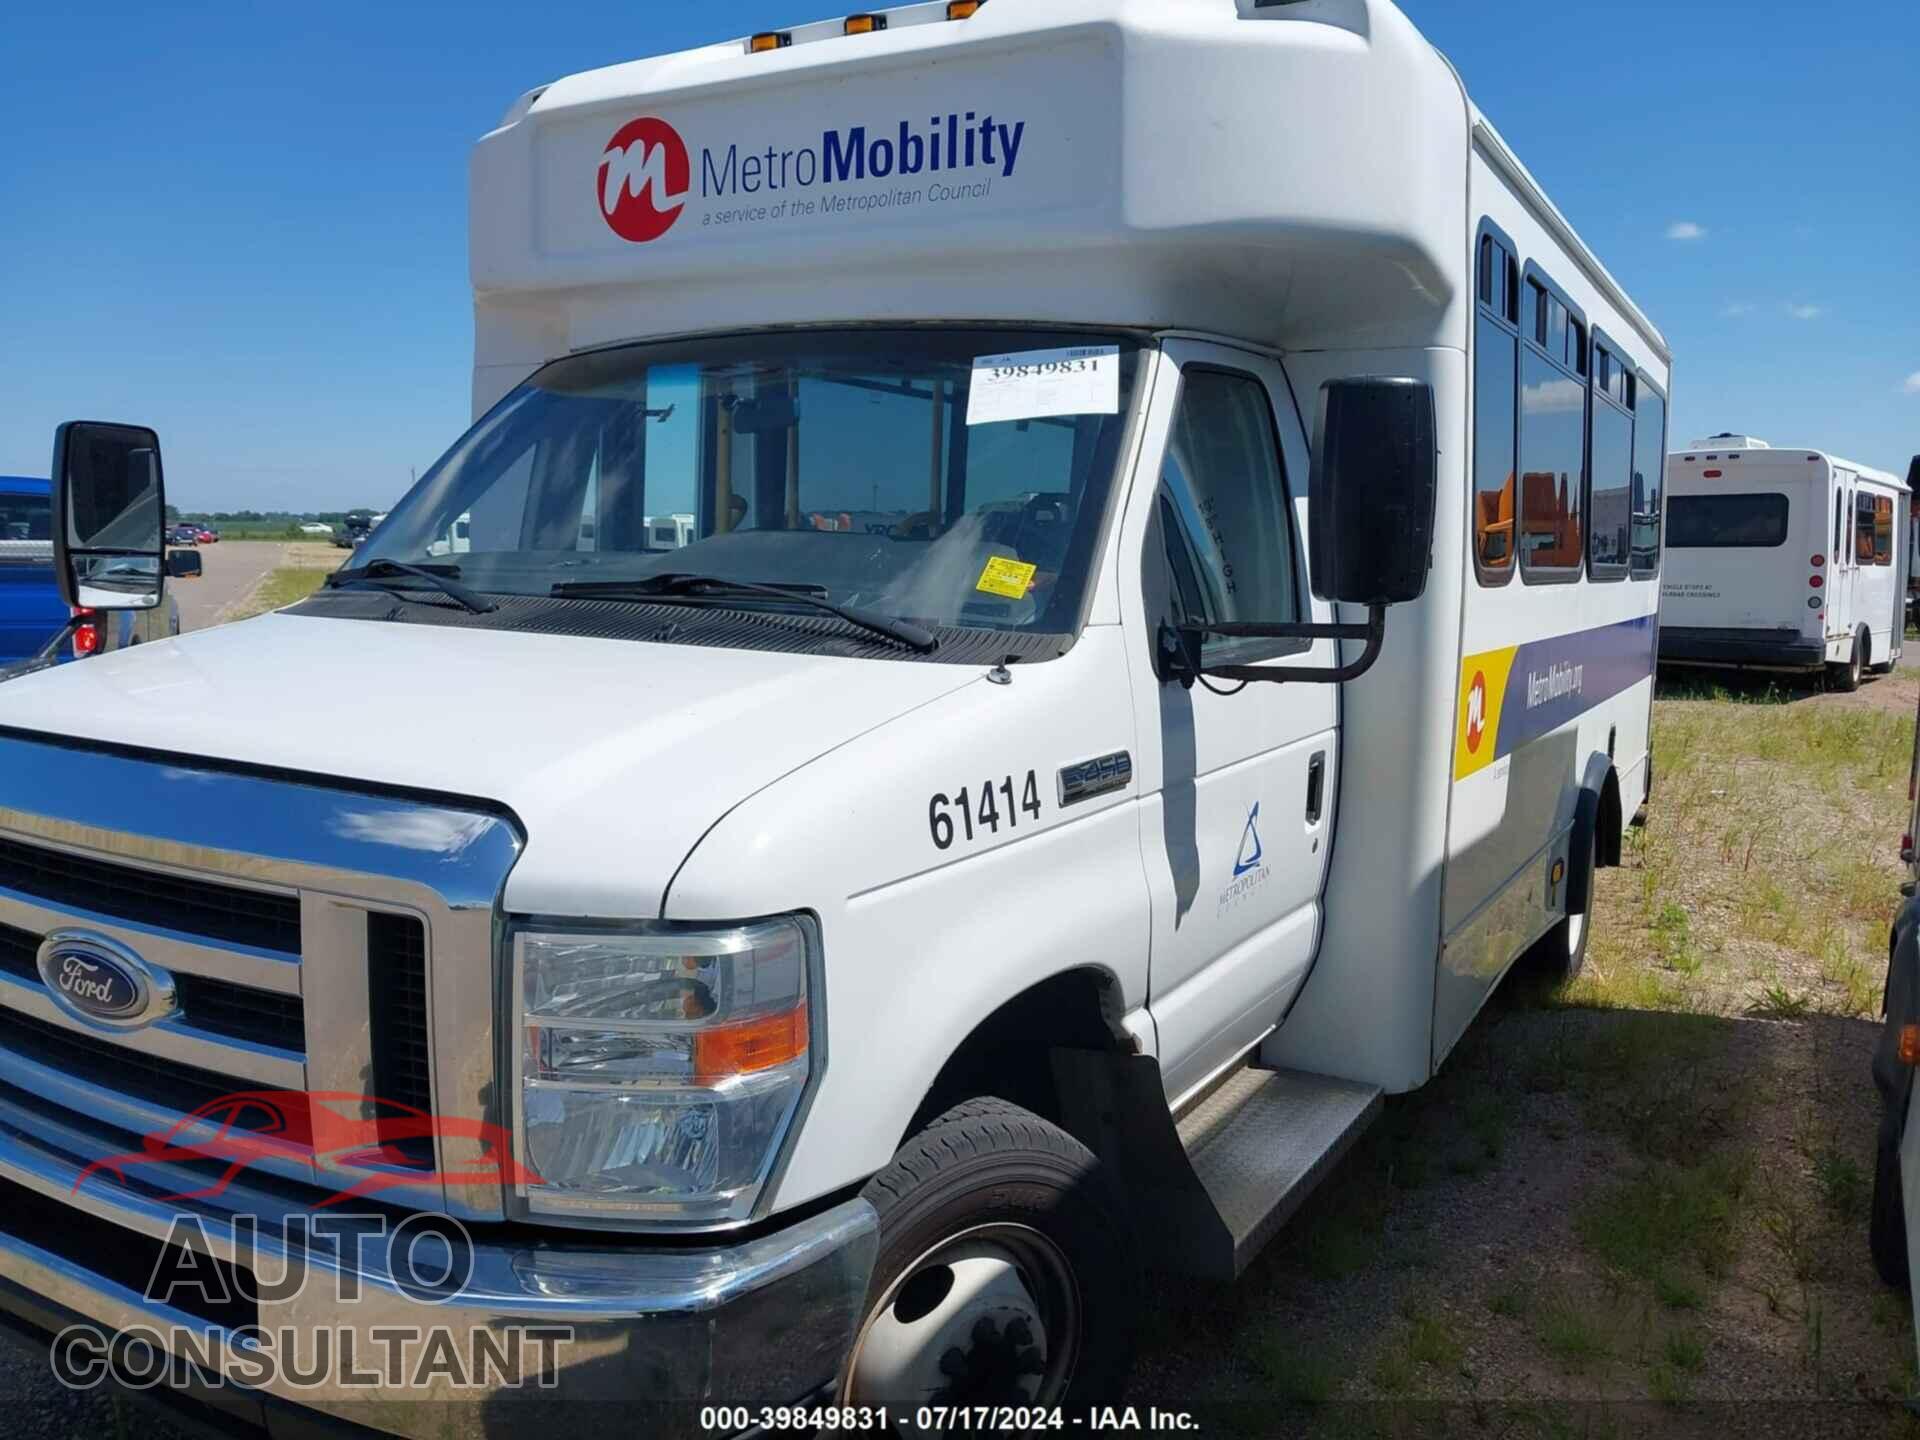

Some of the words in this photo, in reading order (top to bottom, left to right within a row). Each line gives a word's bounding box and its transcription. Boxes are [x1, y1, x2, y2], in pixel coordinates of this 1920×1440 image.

[703, 213, 711, 226] a
[715, 207, 766, 225] service
[771, 202, 787, 219] of
[790, 200, 815, 216] the
[820, 189, 922, 214] Metropolitan
[928, 178, 992, 201] Council
[929, 769, 1041, 850] 61414
[59, 956, 113, 1003] Ford
